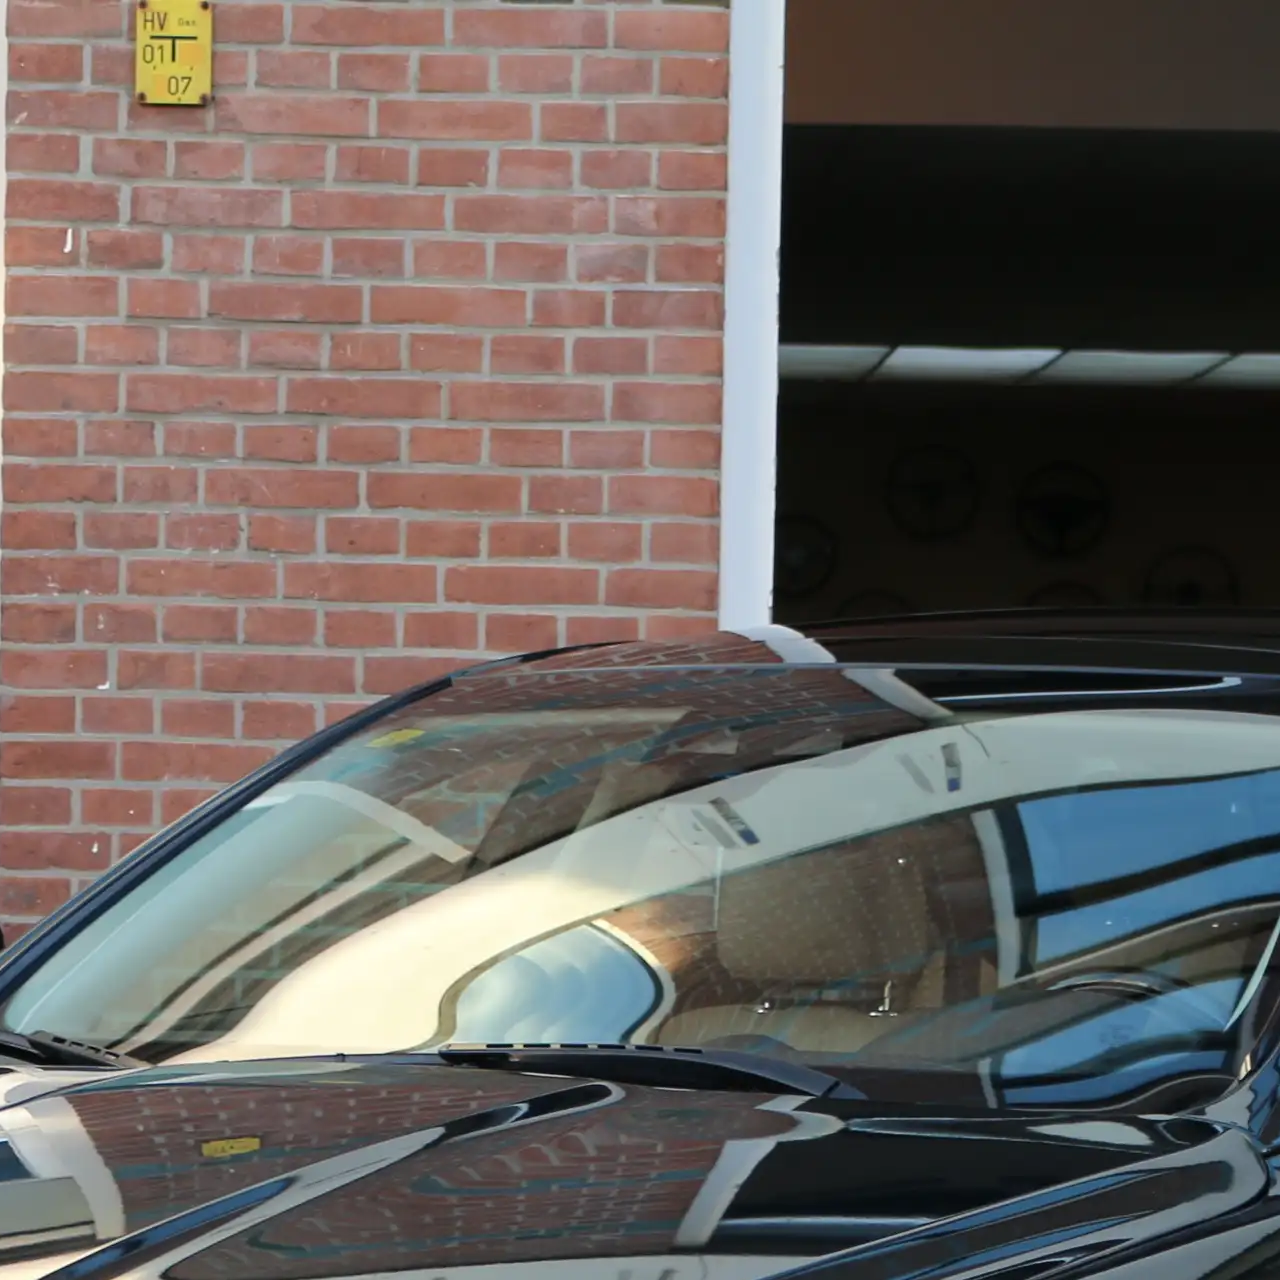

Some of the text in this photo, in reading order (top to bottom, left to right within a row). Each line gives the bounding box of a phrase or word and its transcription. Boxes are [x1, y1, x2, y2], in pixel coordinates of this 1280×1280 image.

[143, 11, 168, 31] HV
[142, 44, 164, 64] 01
[167, 75, 192, 96] 07
